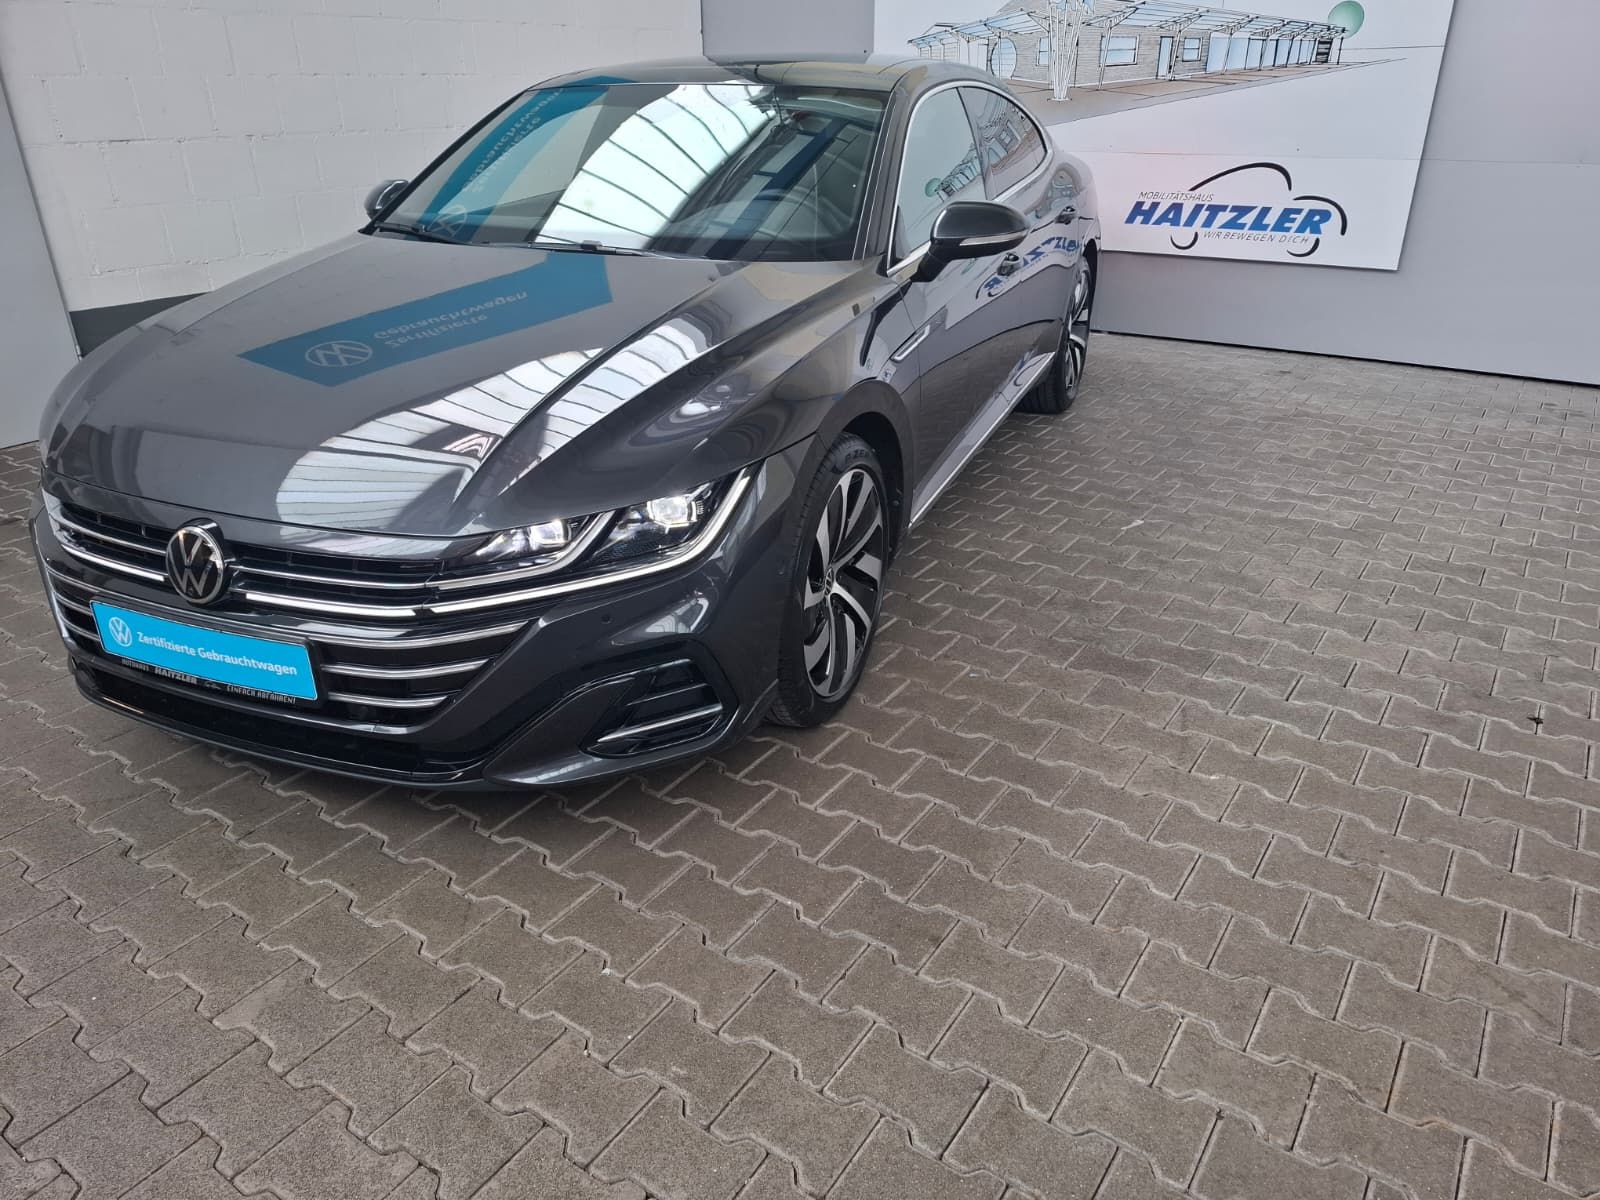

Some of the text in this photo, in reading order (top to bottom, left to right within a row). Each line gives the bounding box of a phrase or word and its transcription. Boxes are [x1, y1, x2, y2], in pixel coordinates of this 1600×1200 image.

[1138, 190, 1215, 202] MOBILITÄTSHAUS
[1124, 201, 1332, 235] HAITZLER
[1203, 231, 1309, 244] WIR BEWEGEN DICH
[136, 631, 196, 657] Zertifizierte
[197, 647, 298, 677] Gebrauchtwagen
[154, 666, 198, 685] HAITZLER
